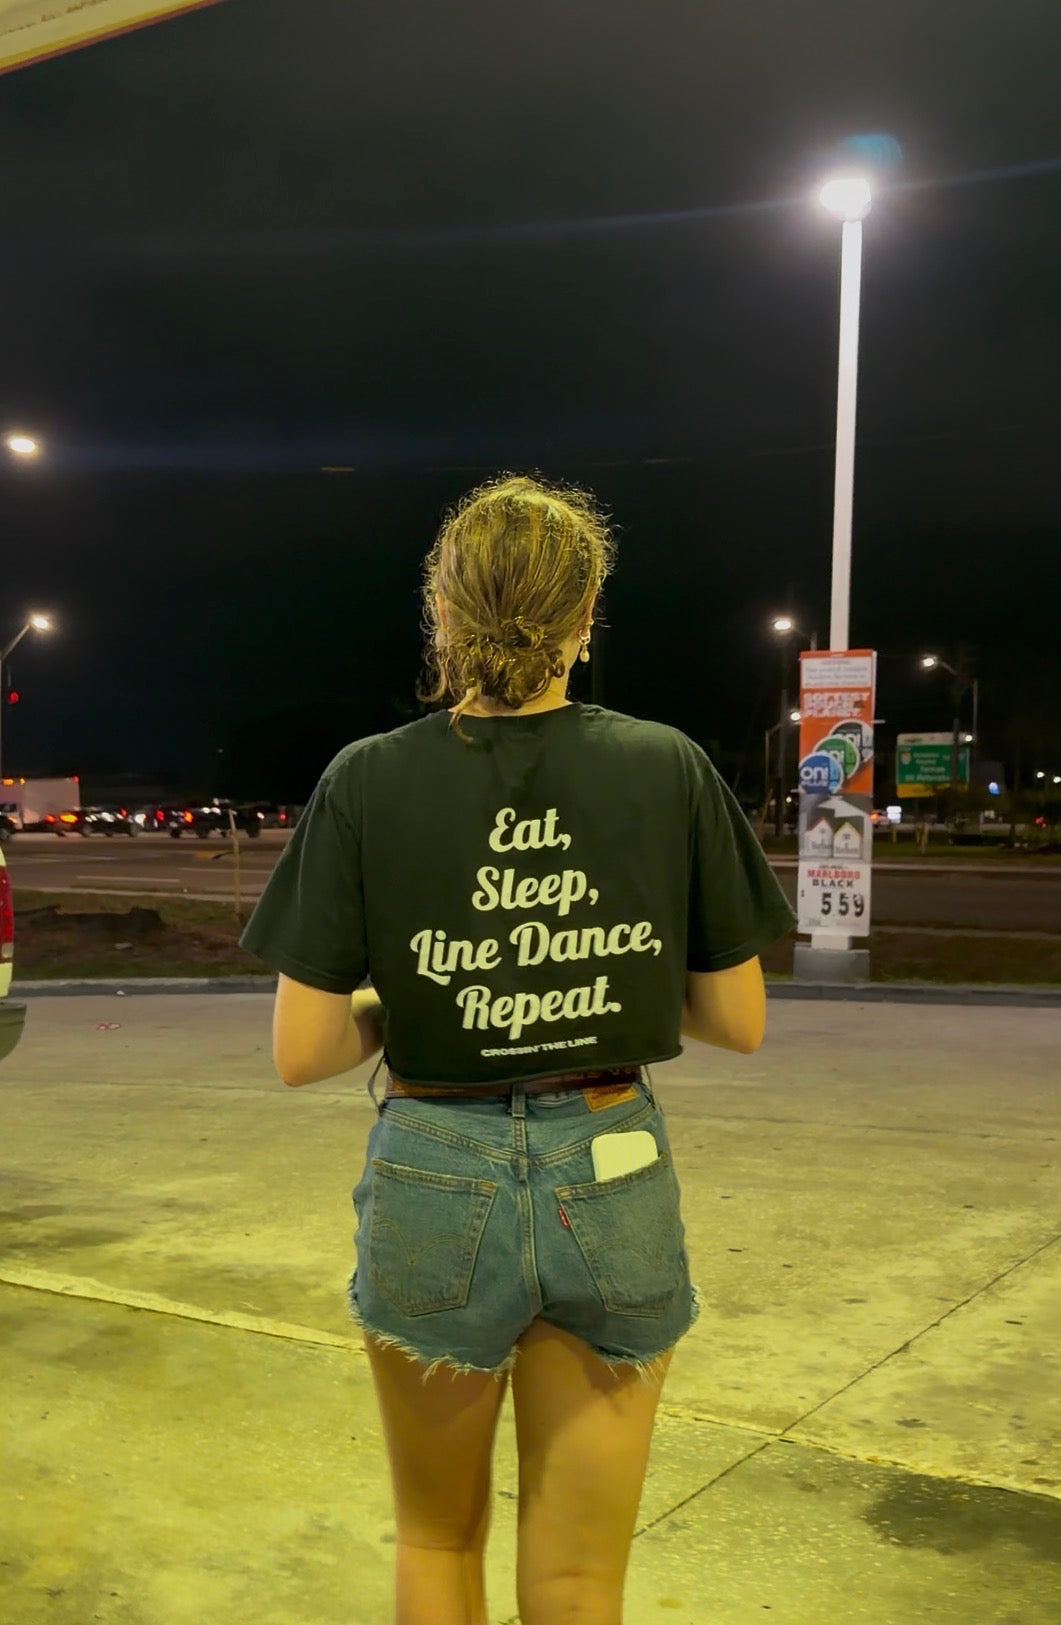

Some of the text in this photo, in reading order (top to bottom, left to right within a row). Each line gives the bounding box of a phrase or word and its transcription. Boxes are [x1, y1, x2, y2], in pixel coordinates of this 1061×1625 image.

[488, 807, 572, 853] Eat,
[472, 865, 599, 916] Sleep,
[807, 869, 861, 880] MARLBORO
[812, 879, 854, 888] BLACK
[410, 920, 662, 986] Line Dance,
[456, 976, 622, 1040] Repeat.
[567, 1036, 598, 1048] LINE
